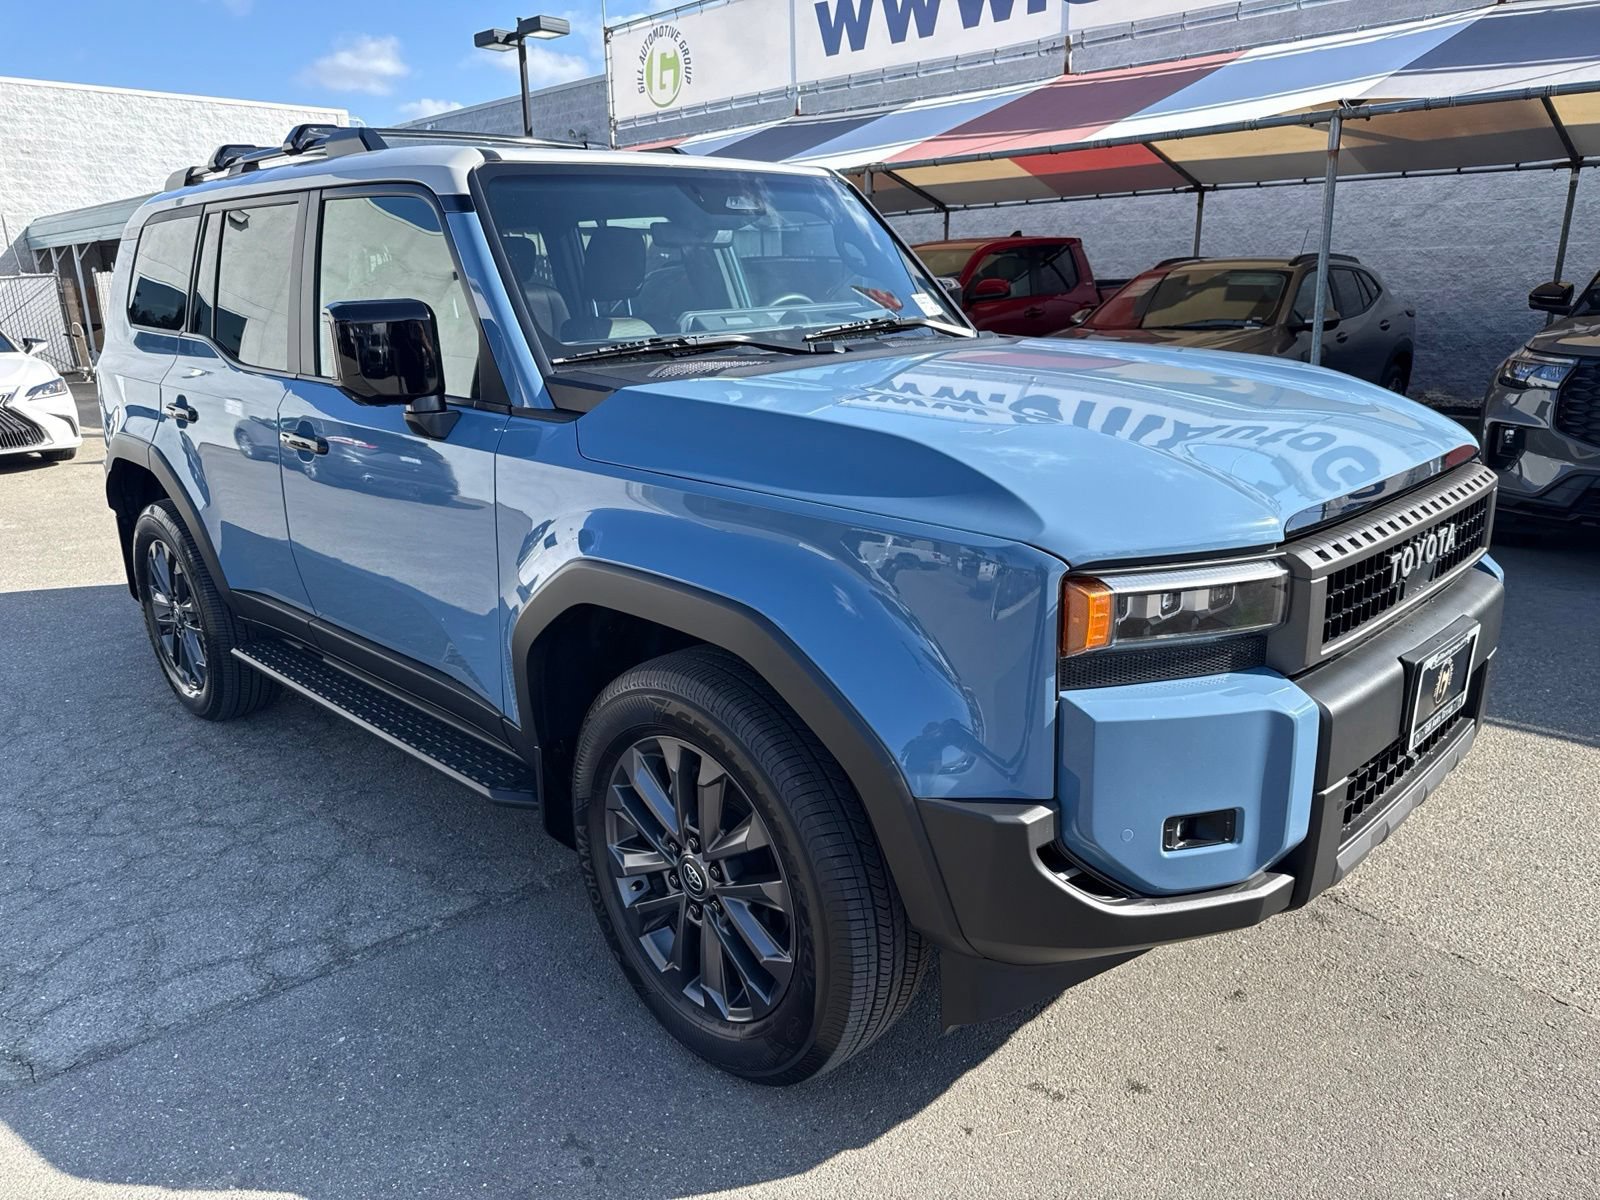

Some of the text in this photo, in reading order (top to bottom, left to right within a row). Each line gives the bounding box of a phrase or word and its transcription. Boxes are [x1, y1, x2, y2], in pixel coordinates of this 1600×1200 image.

[636, 25, 692, 94] GILL AUTOMOTIVE GROUP
[1391, 523, 1455, 584] TOYOTA
